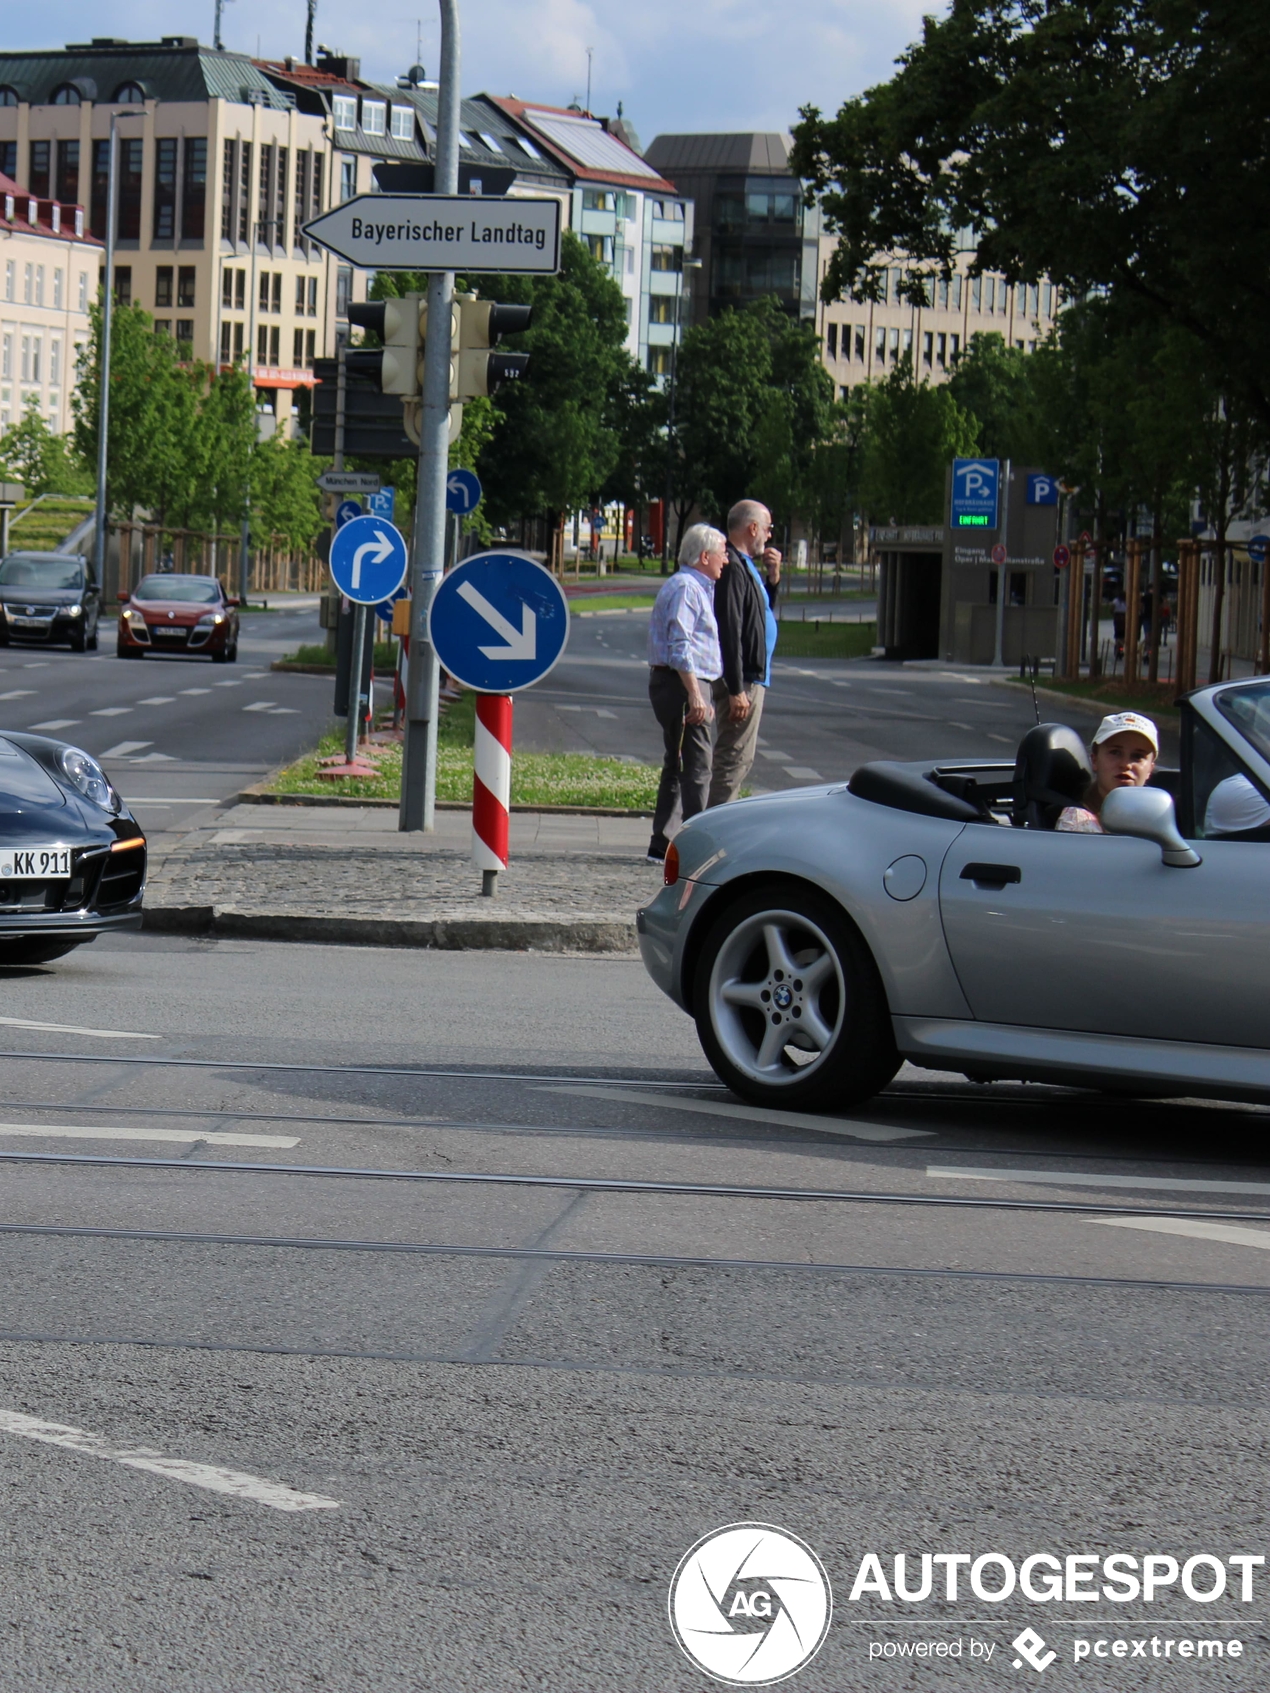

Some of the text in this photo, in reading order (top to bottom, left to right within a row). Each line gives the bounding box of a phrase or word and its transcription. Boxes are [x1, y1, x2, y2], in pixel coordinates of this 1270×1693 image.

[351, 218, 545, 250] Bayerischer Landtag
[325, 476, 378, 486] München Nord
[959, 515, 988, 525] EINFAHRT
[955, 546, 985, 555] Eingang
[955, 555, 973, 564] Oper
[14, 852, 35, 874] KK
[40, 852, 69, 874] 911
